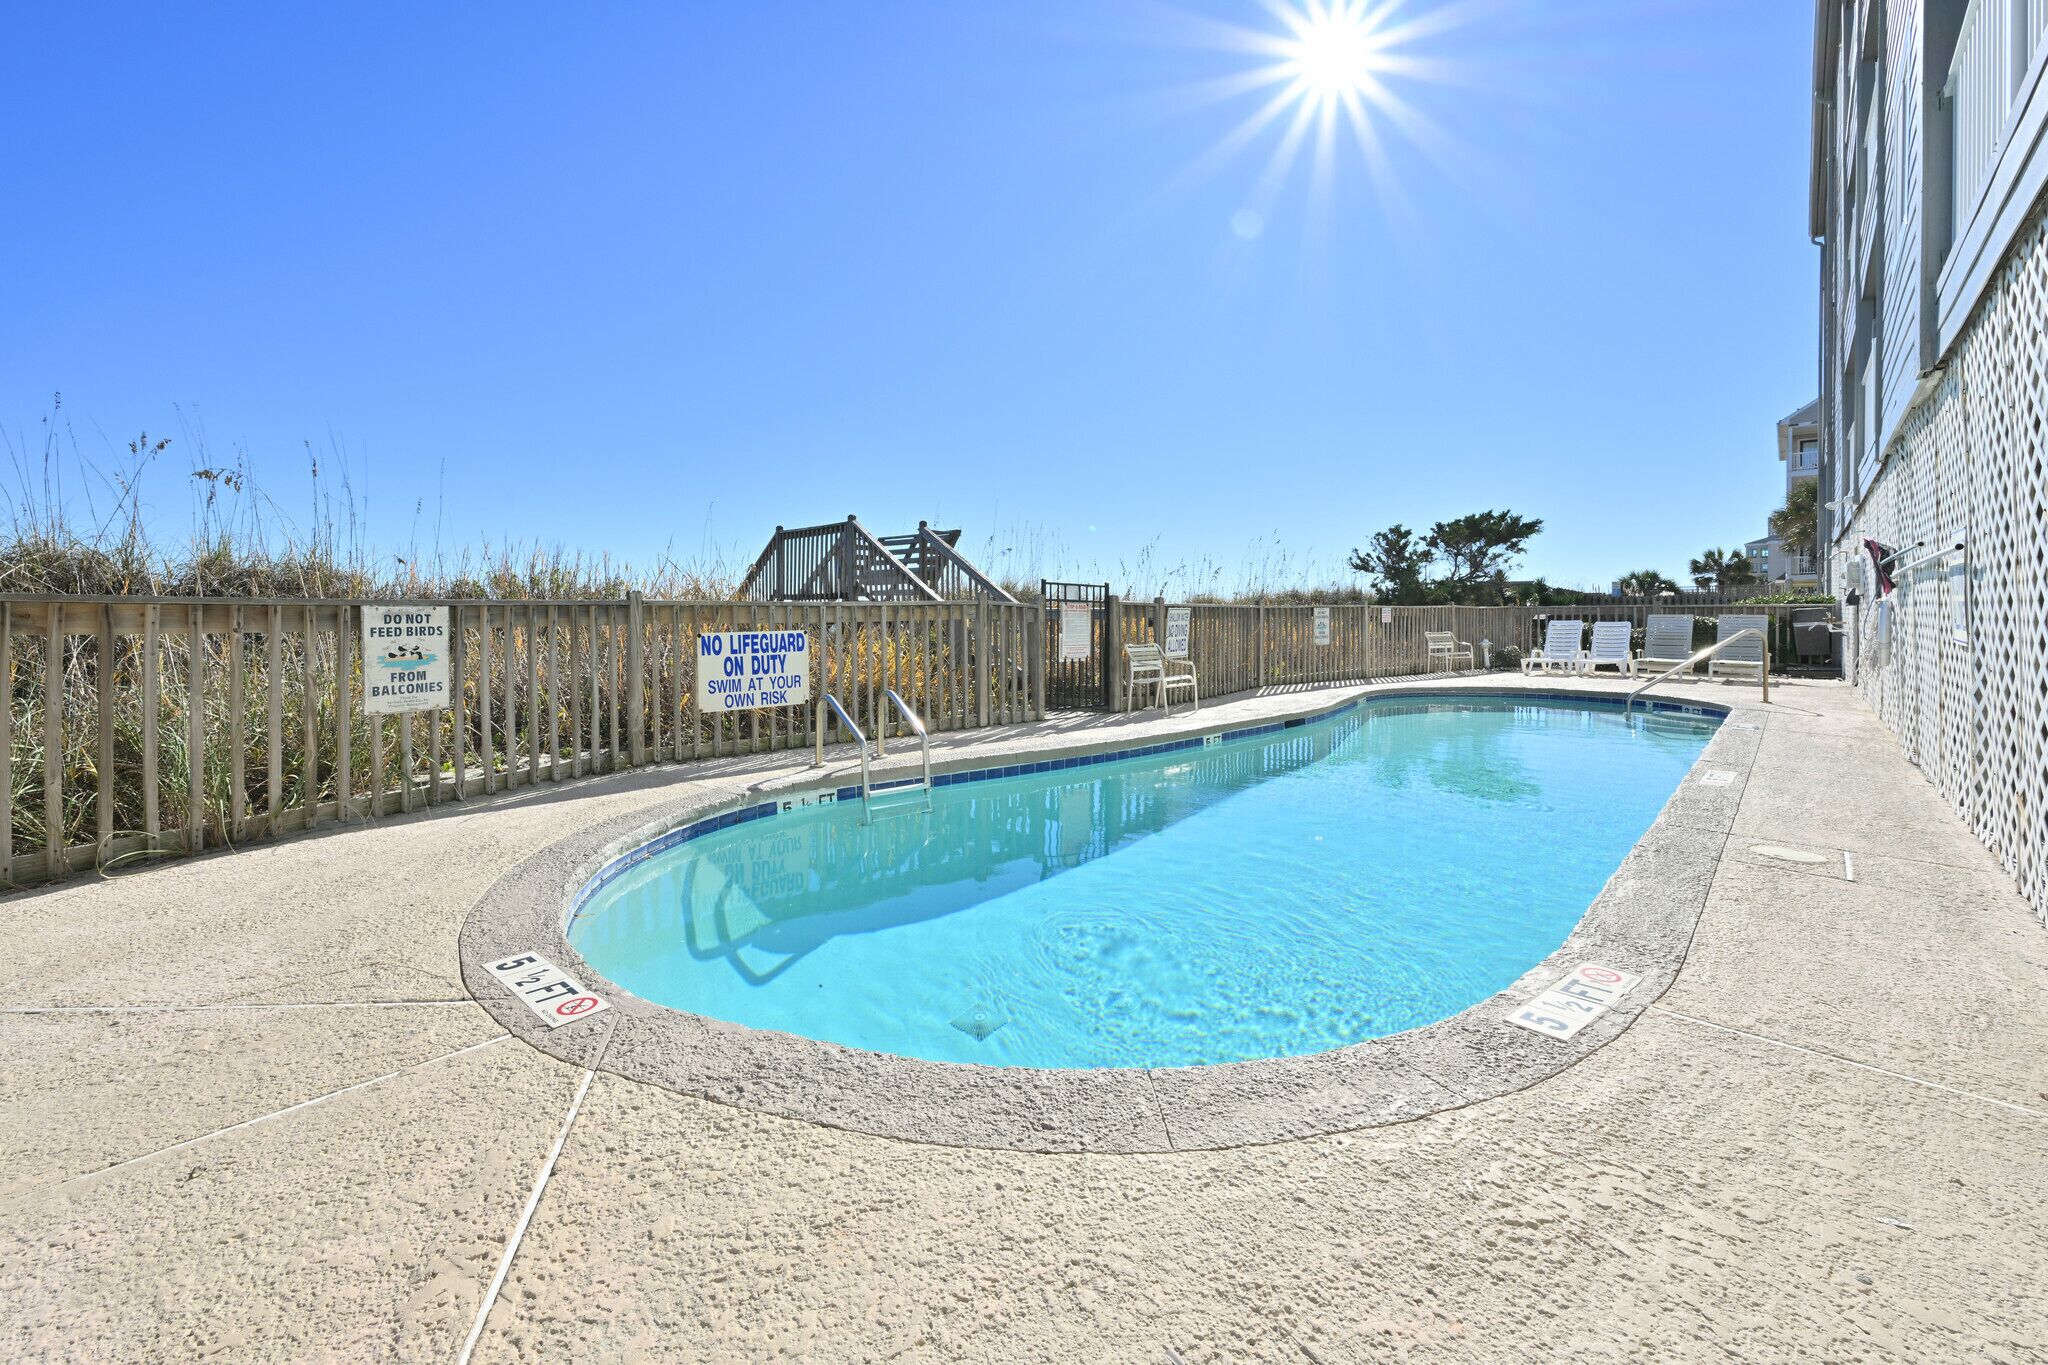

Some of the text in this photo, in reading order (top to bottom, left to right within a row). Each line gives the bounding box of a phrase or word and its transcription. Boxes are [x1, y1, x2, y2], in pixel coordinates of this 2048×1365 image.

[384, 614, 431, 625] DO NOT
[370, 626, 443, 637] FEED BIRDS
[701, 632, 805, 656] NO LIFEGUARD
[723, 654, 787, 677] ON DUTY
[391, 670, 427, 683] FROM
[708, 675, 802, 694] SWIM AT YOUR
[372, 681, 443, 697] BALCONIES
[724, 690, 788, 708] OWN RISK
[495, 956, 538, 971] 5
[525, 981, 579, 1004] FT
[1519, 1011, 1569, 1032] 5
[1560, 978, 1613, 1002] FT
